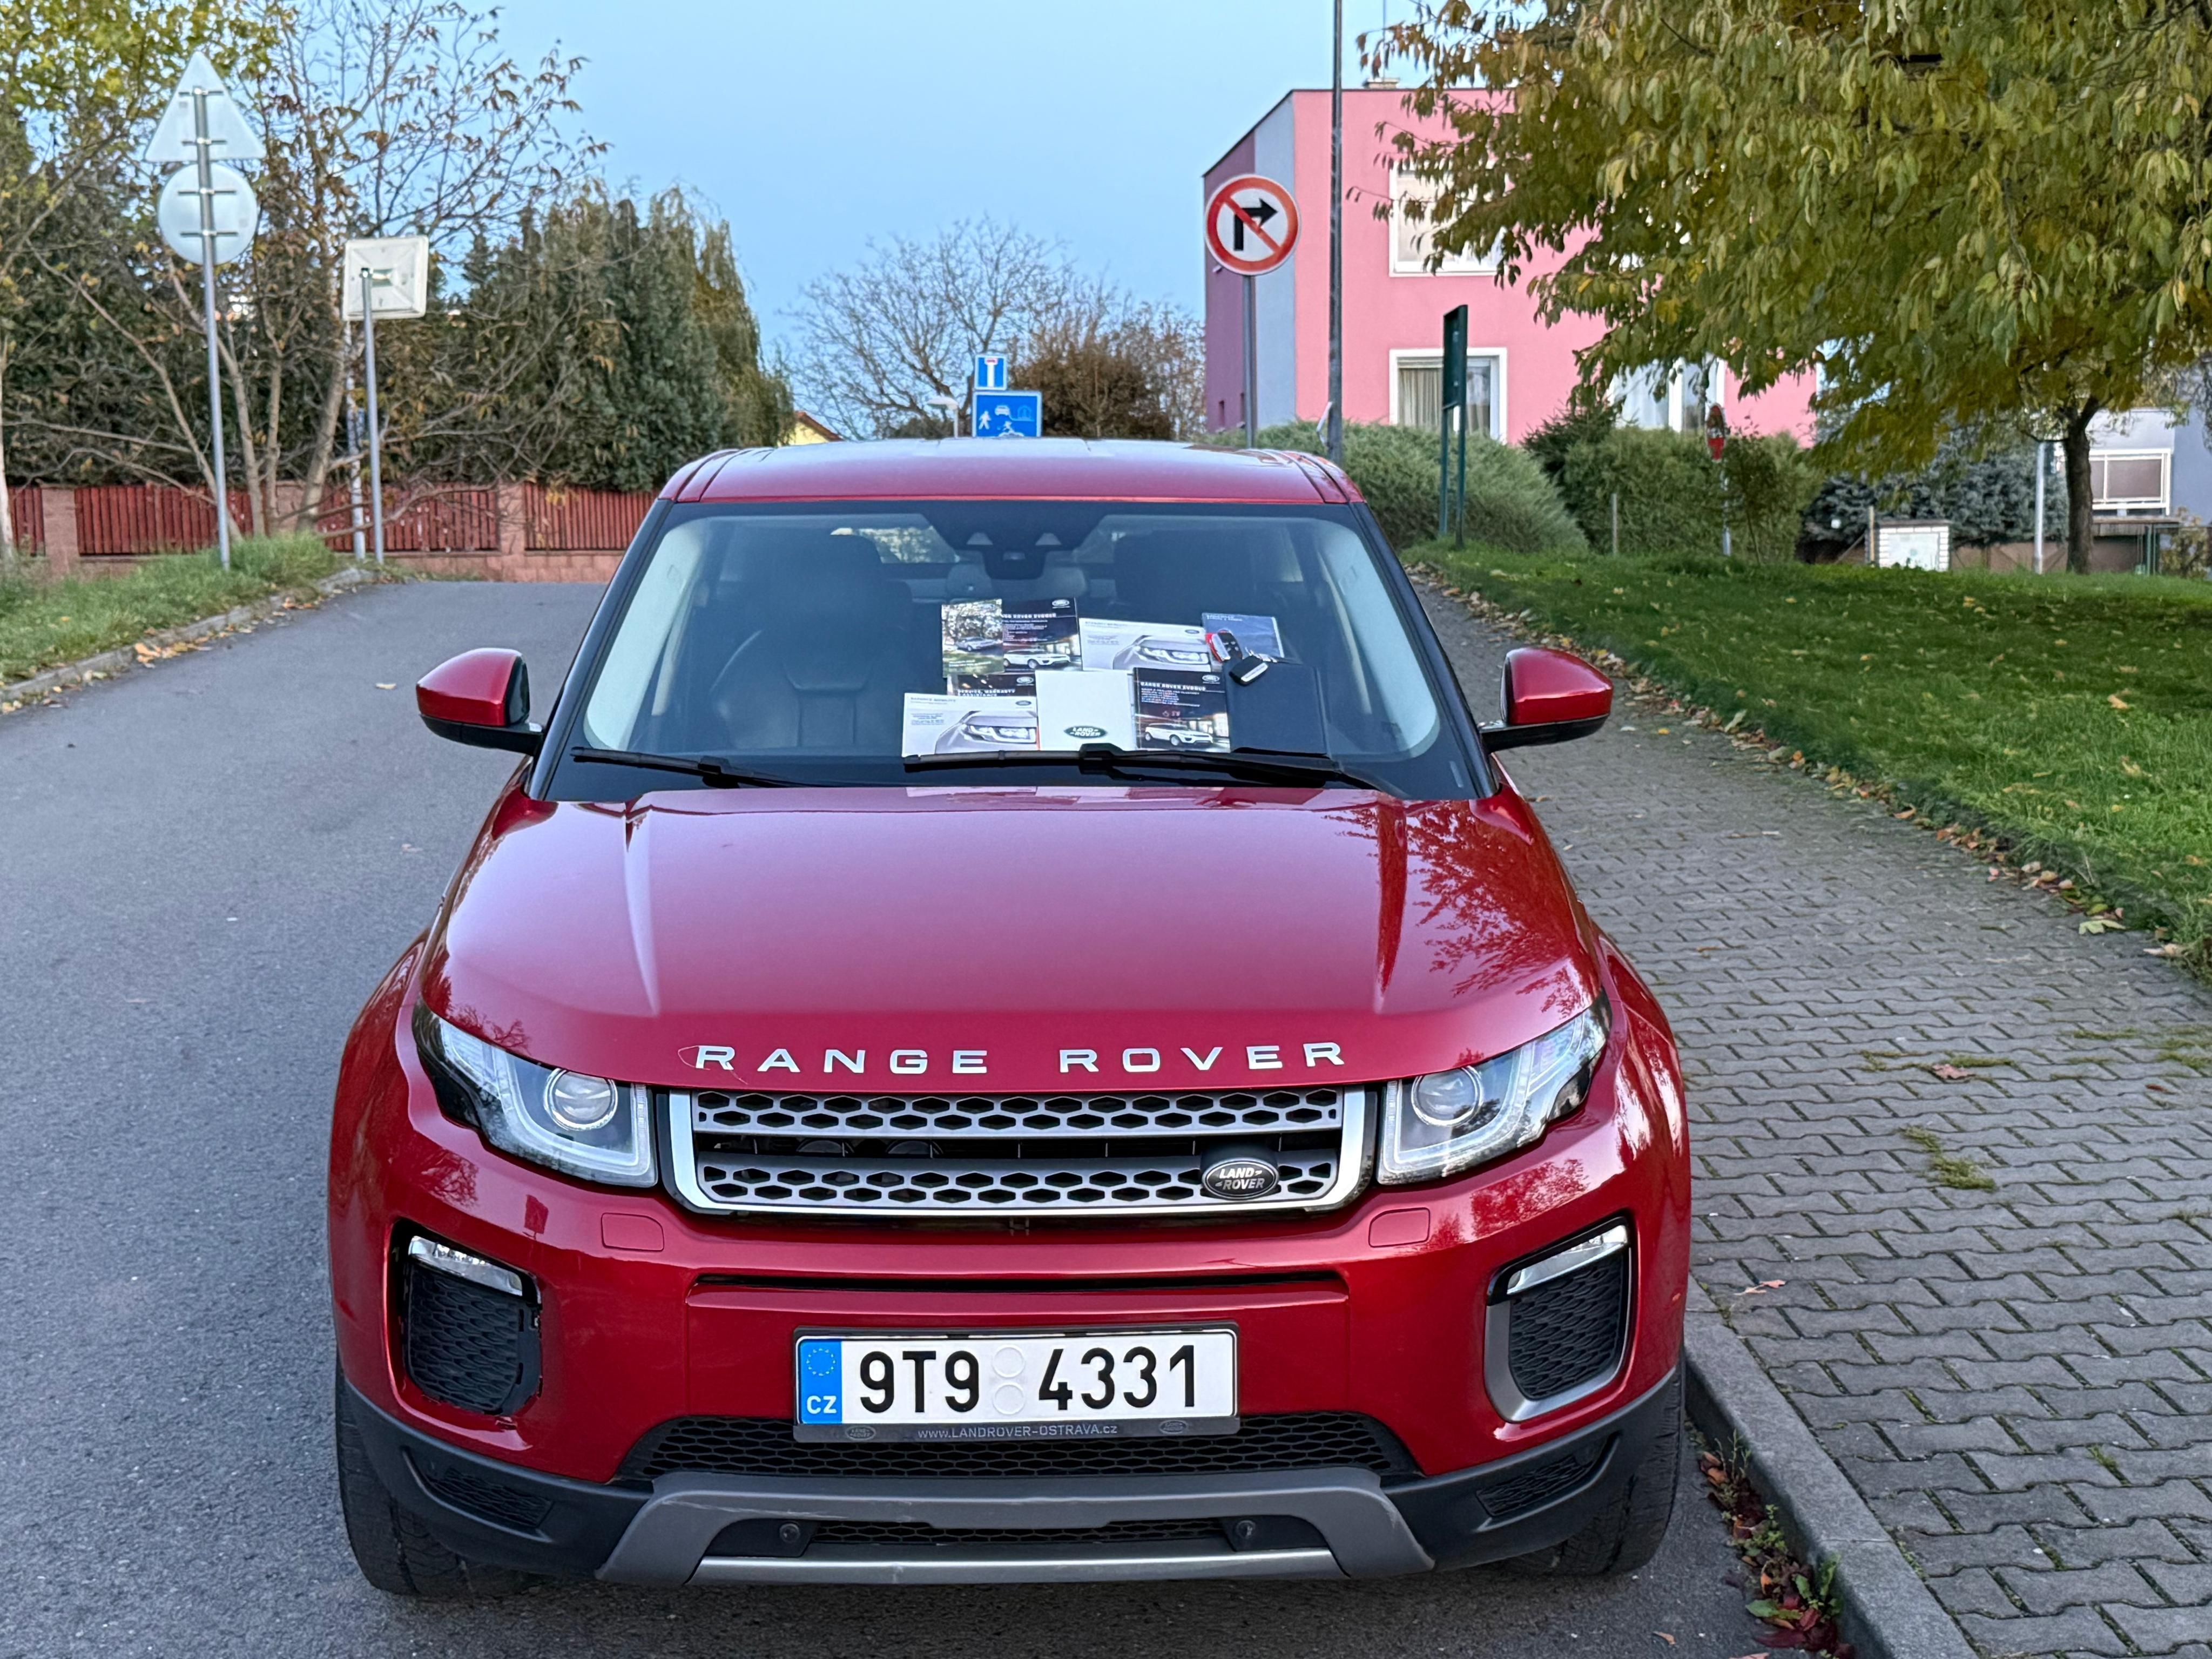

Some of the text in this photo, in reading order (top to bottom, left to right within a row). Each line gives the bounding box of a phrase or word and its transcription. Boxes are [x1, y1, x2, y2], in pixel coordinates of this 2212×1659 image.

[695, 1042, 1345, 1074] RANGE ROVER
[1222, 1178, 1265, 1190] ROVER
[859, 1344, 1196, 1413] 9T9 4331
[807, 1395, 837, 1414] CZ
